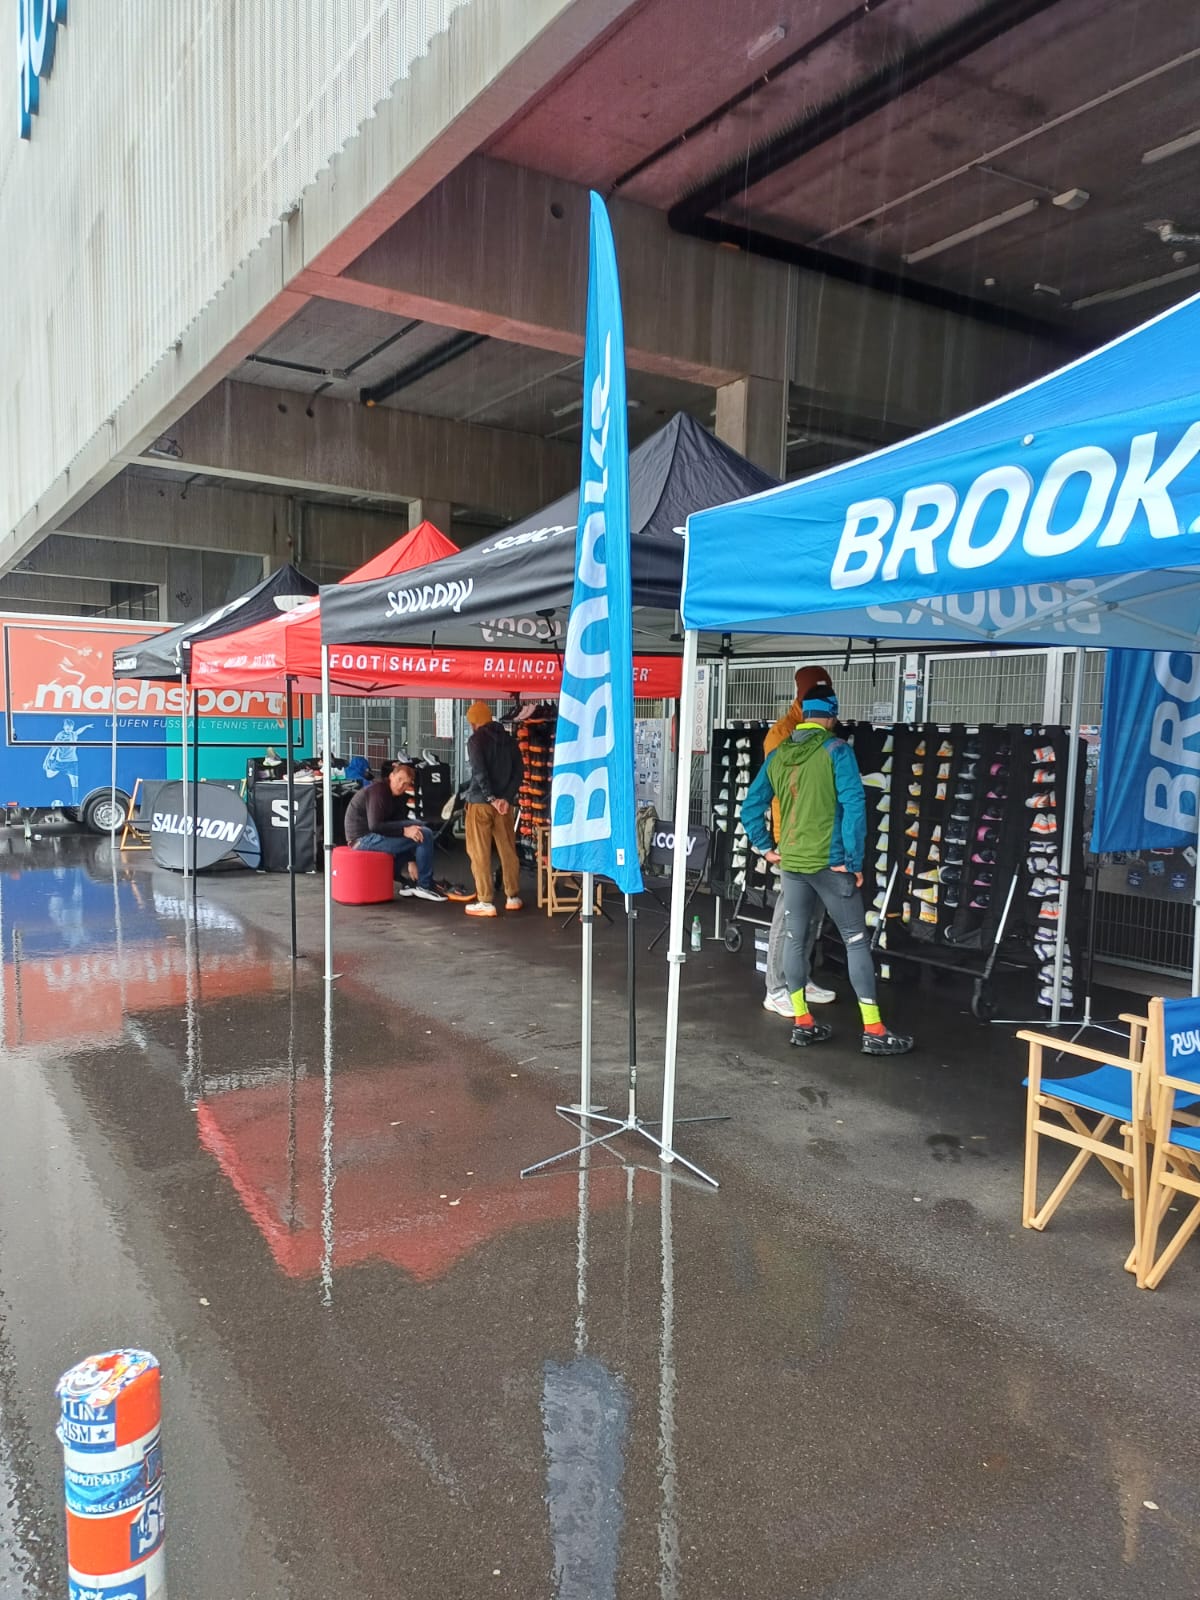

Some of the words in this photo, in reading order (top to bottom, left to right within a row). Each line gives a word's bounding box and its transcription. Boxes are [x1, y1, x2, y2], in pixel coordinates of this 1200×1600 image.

[830, 420, 1200, 591] BROOK
[34, 679, 286, 716] machsport
[105, 719, 149, 728] LAUFEN
[153, 719, 207, 729] FUSSAL
[210, 720, 248, 730] TENNIS
[252, 721, 280, 731] TEAM
[1143, 652, 1200, 833] BRO
